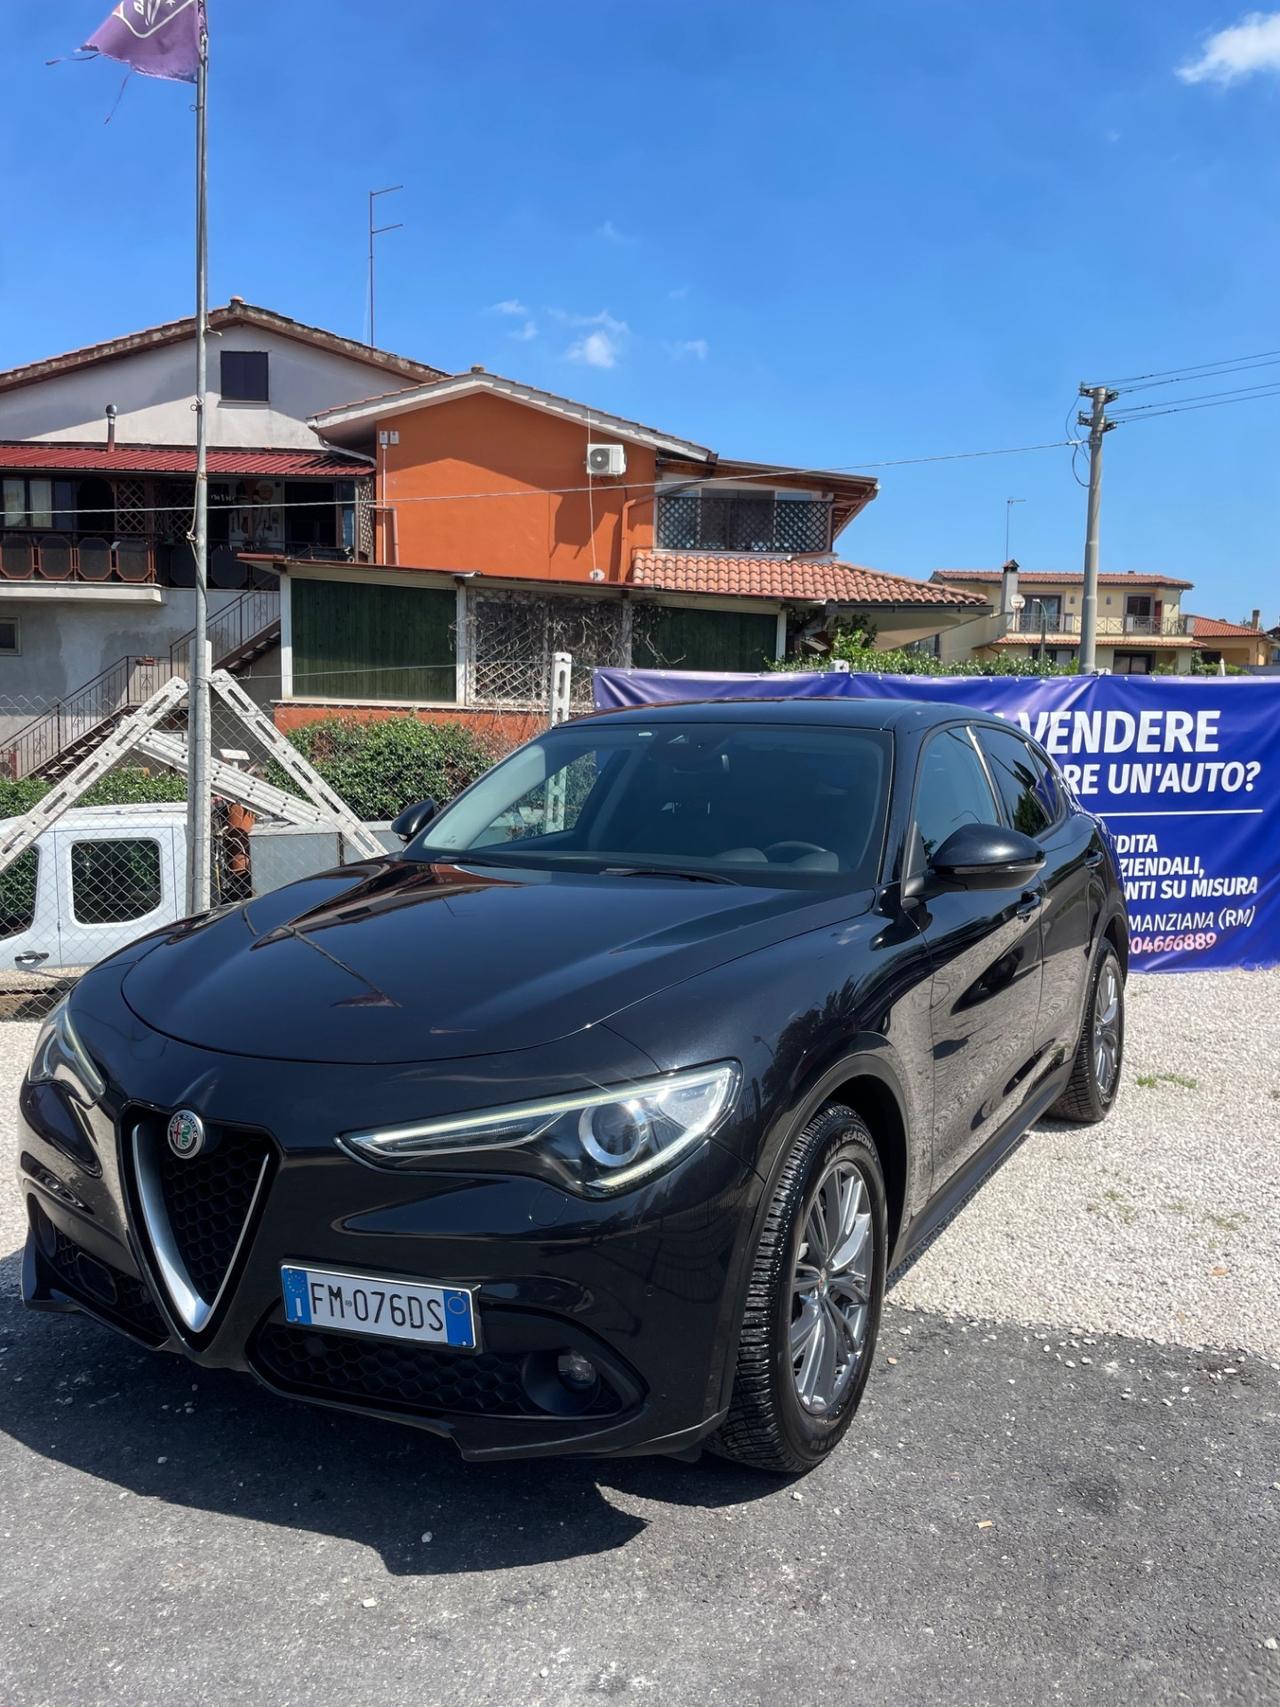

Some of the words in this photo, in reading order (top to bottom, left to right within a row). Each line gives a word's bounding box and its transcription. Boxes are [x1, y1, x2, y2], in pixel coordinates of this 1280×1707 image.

[1017, 710, 1221, 755] VENDERE
[1108, 760, 1262, 795] UN'AUTO?
[1113, 834, 1158, 853] DITA
[1124, 880, 1157, 900] NTI
[1160, 879, 1187, 899] SU
[1191, 876, 1258, 898] MISURA
[1128, 911, 1214, 932] MANZIANA
[1218, 905, 1256, 930] (RM)
[1128, 932, 1217, 954] 04666889
